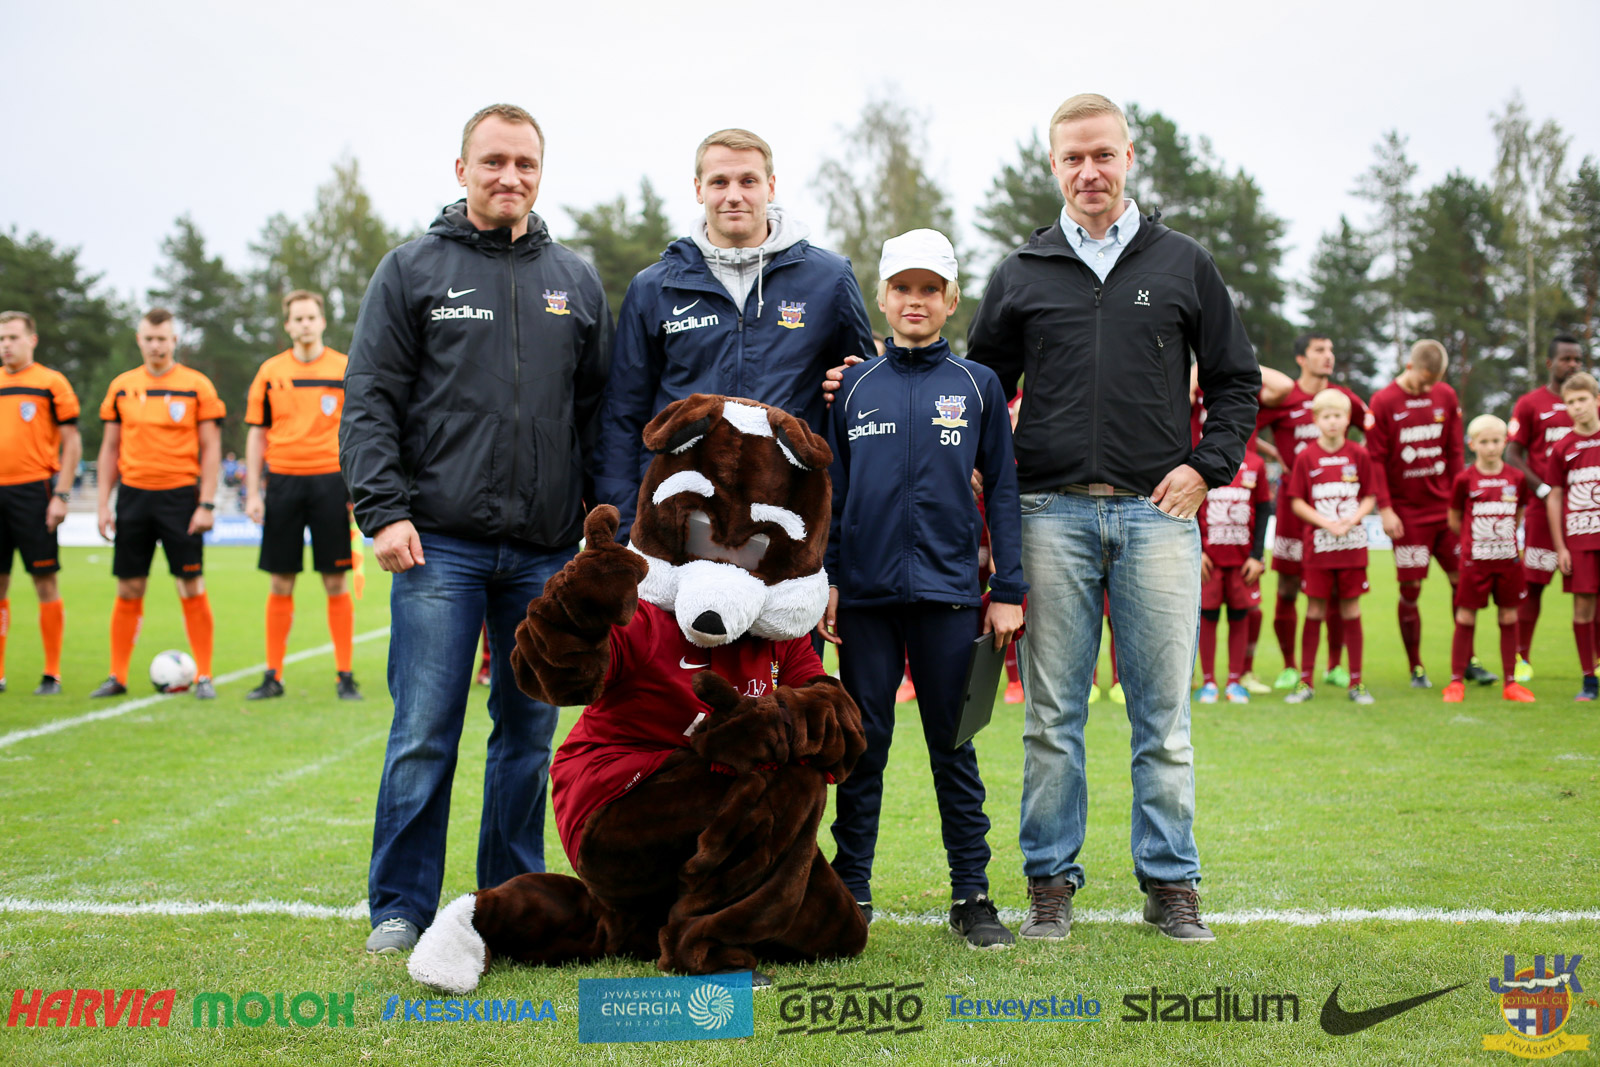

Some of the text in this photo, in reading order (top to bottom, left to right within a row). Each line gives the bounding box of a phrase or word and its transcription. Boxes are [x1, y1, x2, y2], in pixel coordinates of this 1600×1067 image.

[431, 305, 494, 321] stadium
[662, 314, 719, 335] stadium
[848, 421, 896, 441] sadium
[939, 429, 961, 446] 50
